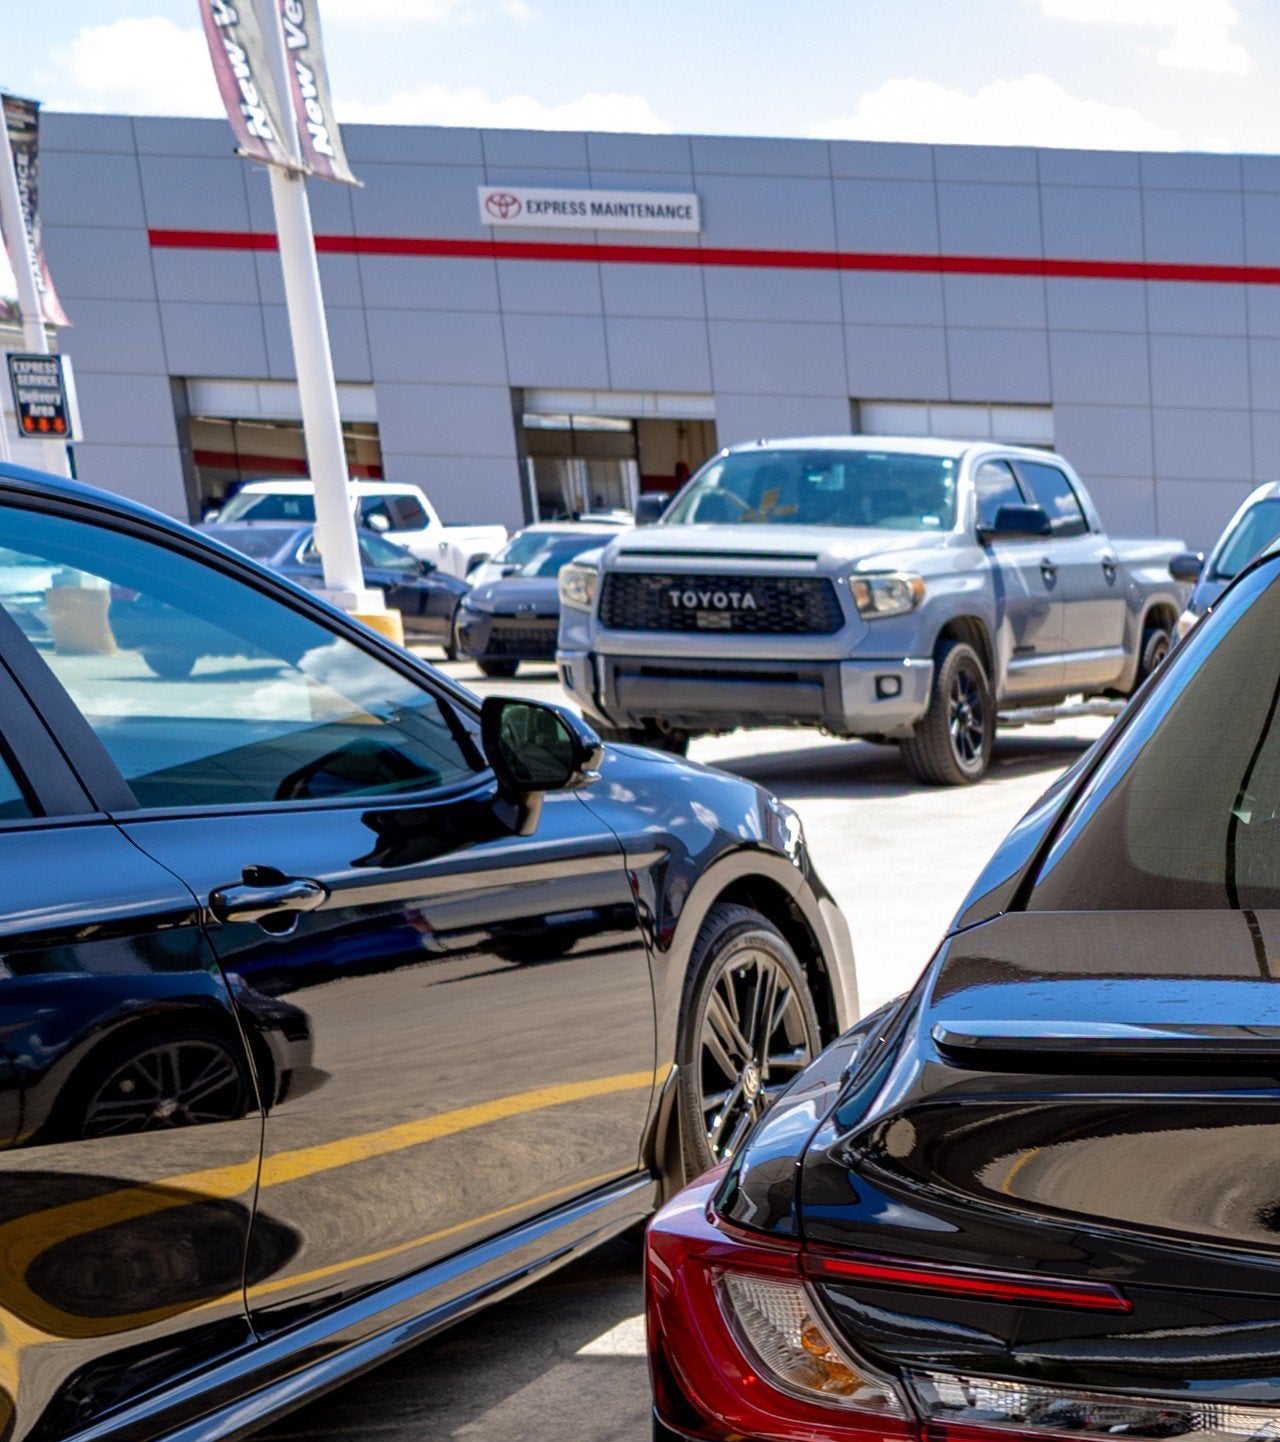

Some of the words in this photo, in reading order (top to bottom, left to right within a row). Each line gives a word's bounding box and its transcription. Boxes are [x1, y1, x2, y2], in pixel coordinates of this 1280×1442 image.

[224, 37, 274, 141] New
[294, 59, 336, 158] New
[526, 199, 587, 216] EXPRESS
[590, 202, 693, 220] MAINTENANCE
[669, 590, 757, 609] TOYOTA
